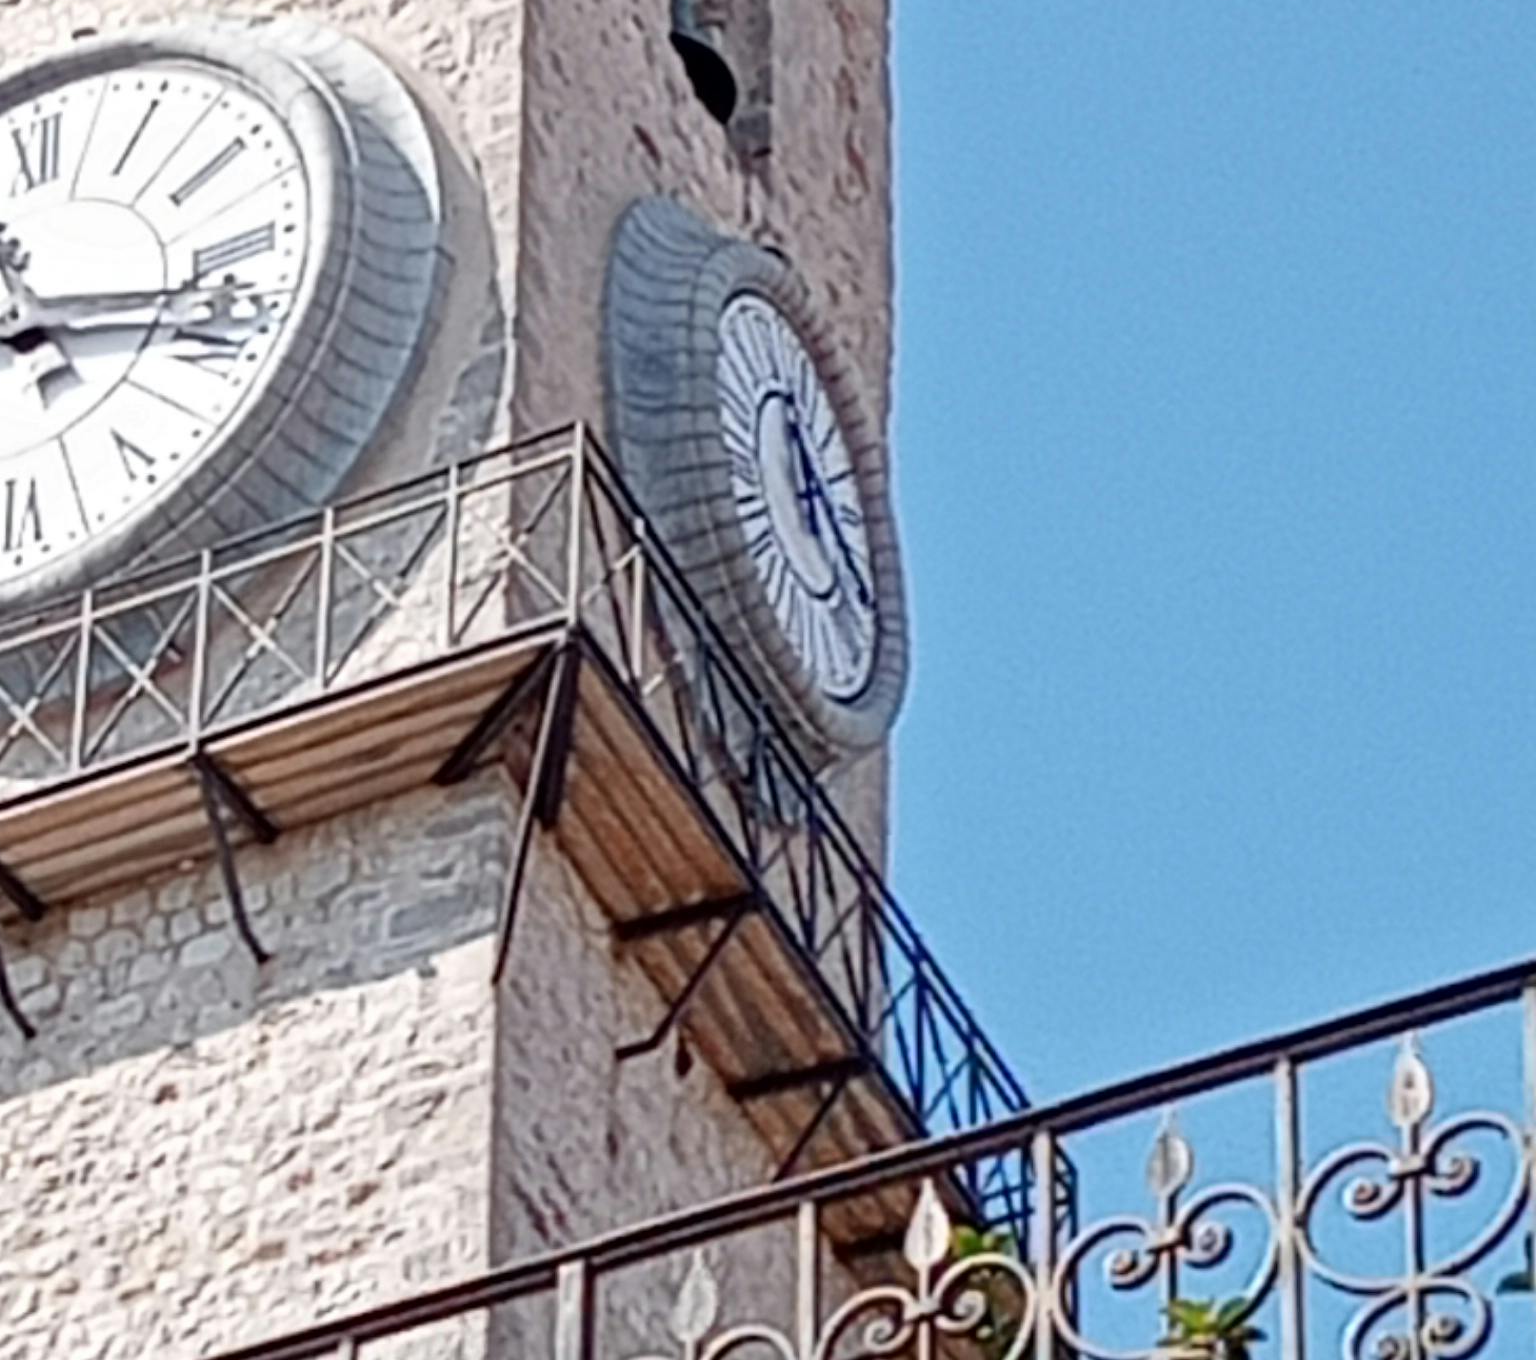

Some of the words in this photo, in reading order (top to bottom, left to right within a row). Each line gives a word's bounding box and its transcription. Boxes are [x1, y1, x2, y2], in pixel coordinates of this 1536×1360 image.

[8, 111, 63, 198] XII
[111, 98, 160, 176] I
[168, 136, 248, 207] II
[192, 220, 276, 281] III
[110, 425, 156, 481] V
[3, 477, 42, 552] VI
